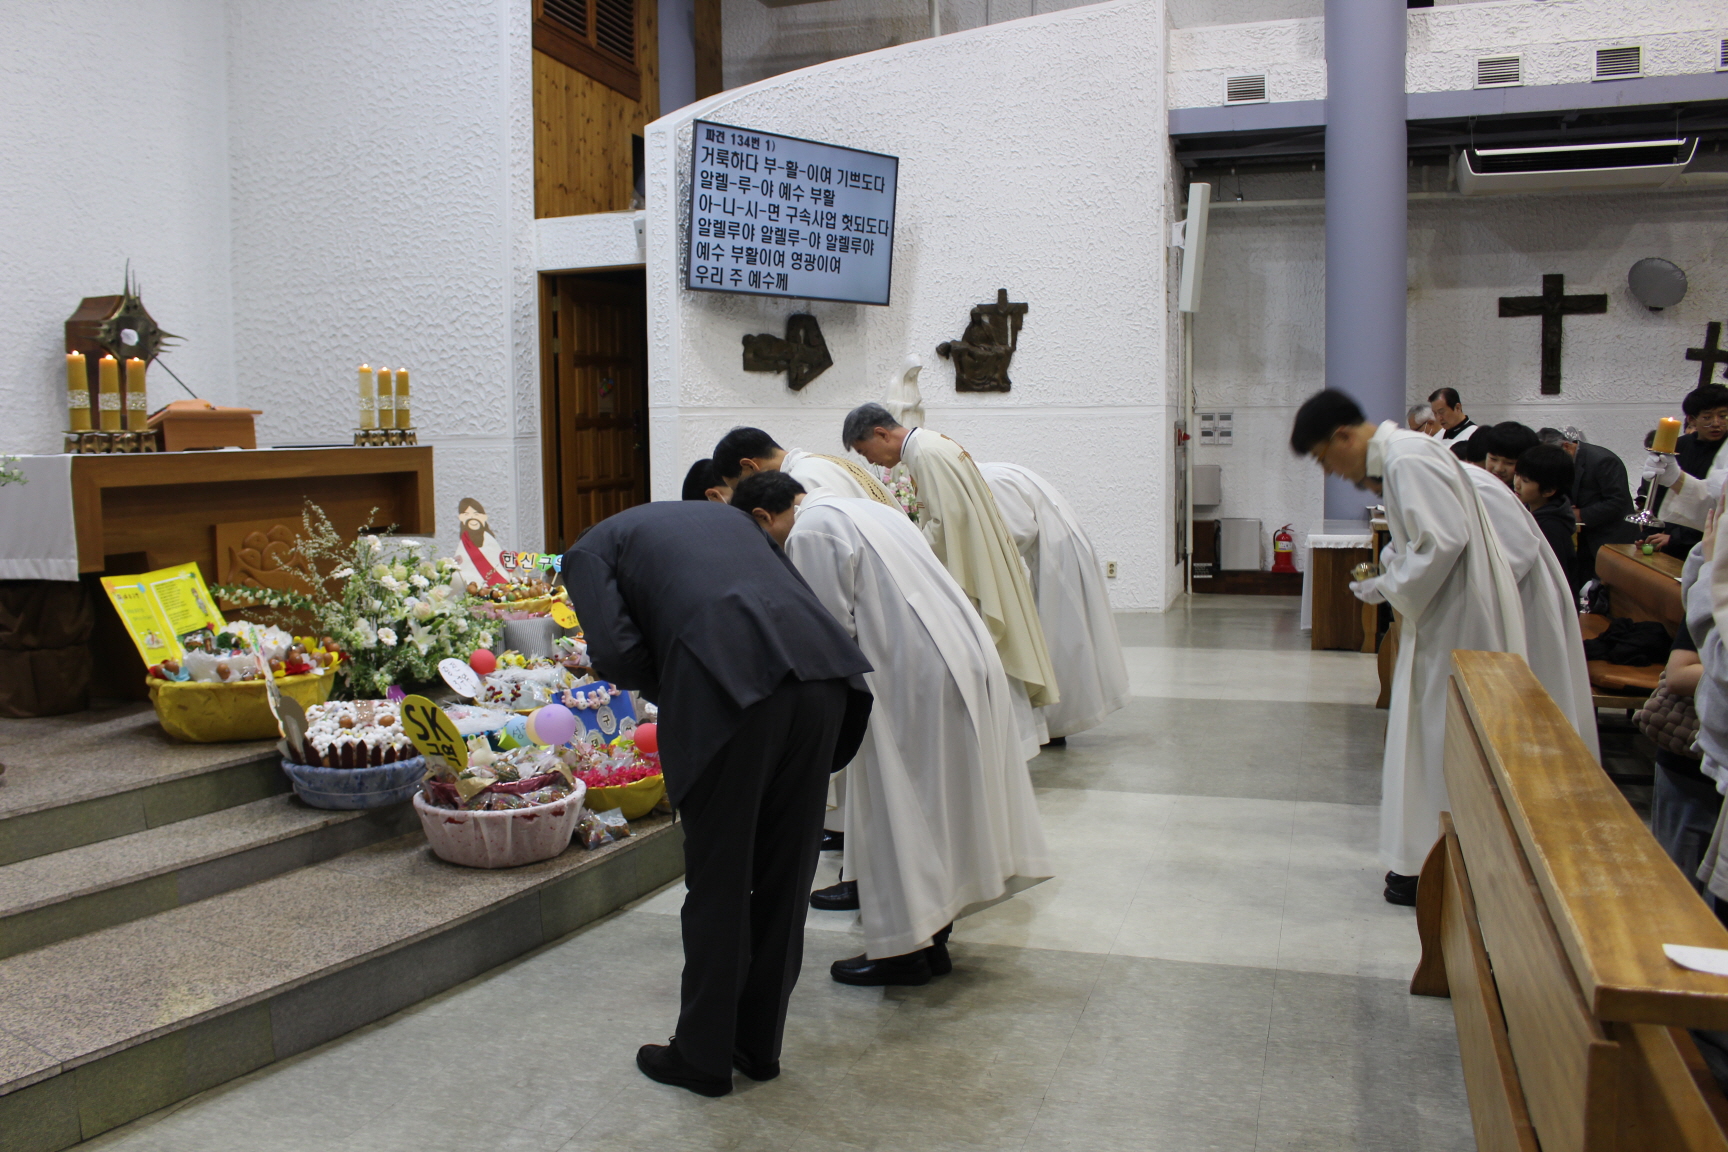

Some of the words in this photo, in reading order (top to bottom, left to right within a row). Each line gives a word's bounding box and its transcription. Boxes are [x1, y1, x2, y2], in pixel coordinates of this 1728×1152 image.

[705, 128, 725, 144] 파견
[731, 133, 760, 150] 134번
[765, 139, 776, 152] 1)
[700, 169, 774, 198] 알렐-루-야
[779, 182, 805, 203] 예수
[810, 186, 835, 207] 부활
[701, 145, 759, 173] 거룩하다
[764, 156, 832, 185] 부-활-이여
[837, 168, 885, 194] 기쁘도다
[699, 193, 780, 222] 아-니-시-면
[786, 205, 837, 230] 구속사업
[842, 213, 889, 237] 헛되도다
[698, 217, 755, 242] 알렐루야
[761, 225, 821, 250] 알렐루-야
[826, 233, 874, 256] 알렐루야
[696, 241, 725, 262] 예수
[731, 245, 785, 268] 부활이여
[791, 251, 841, 275] 영광이여
[695, 265, 723, 286] 우리
[729, 268, 743, 287] 주
[748, 269, 788, 291] 예수께
[404, 704, 454, 743] SK
[426, 743, 462, 767] 구역
